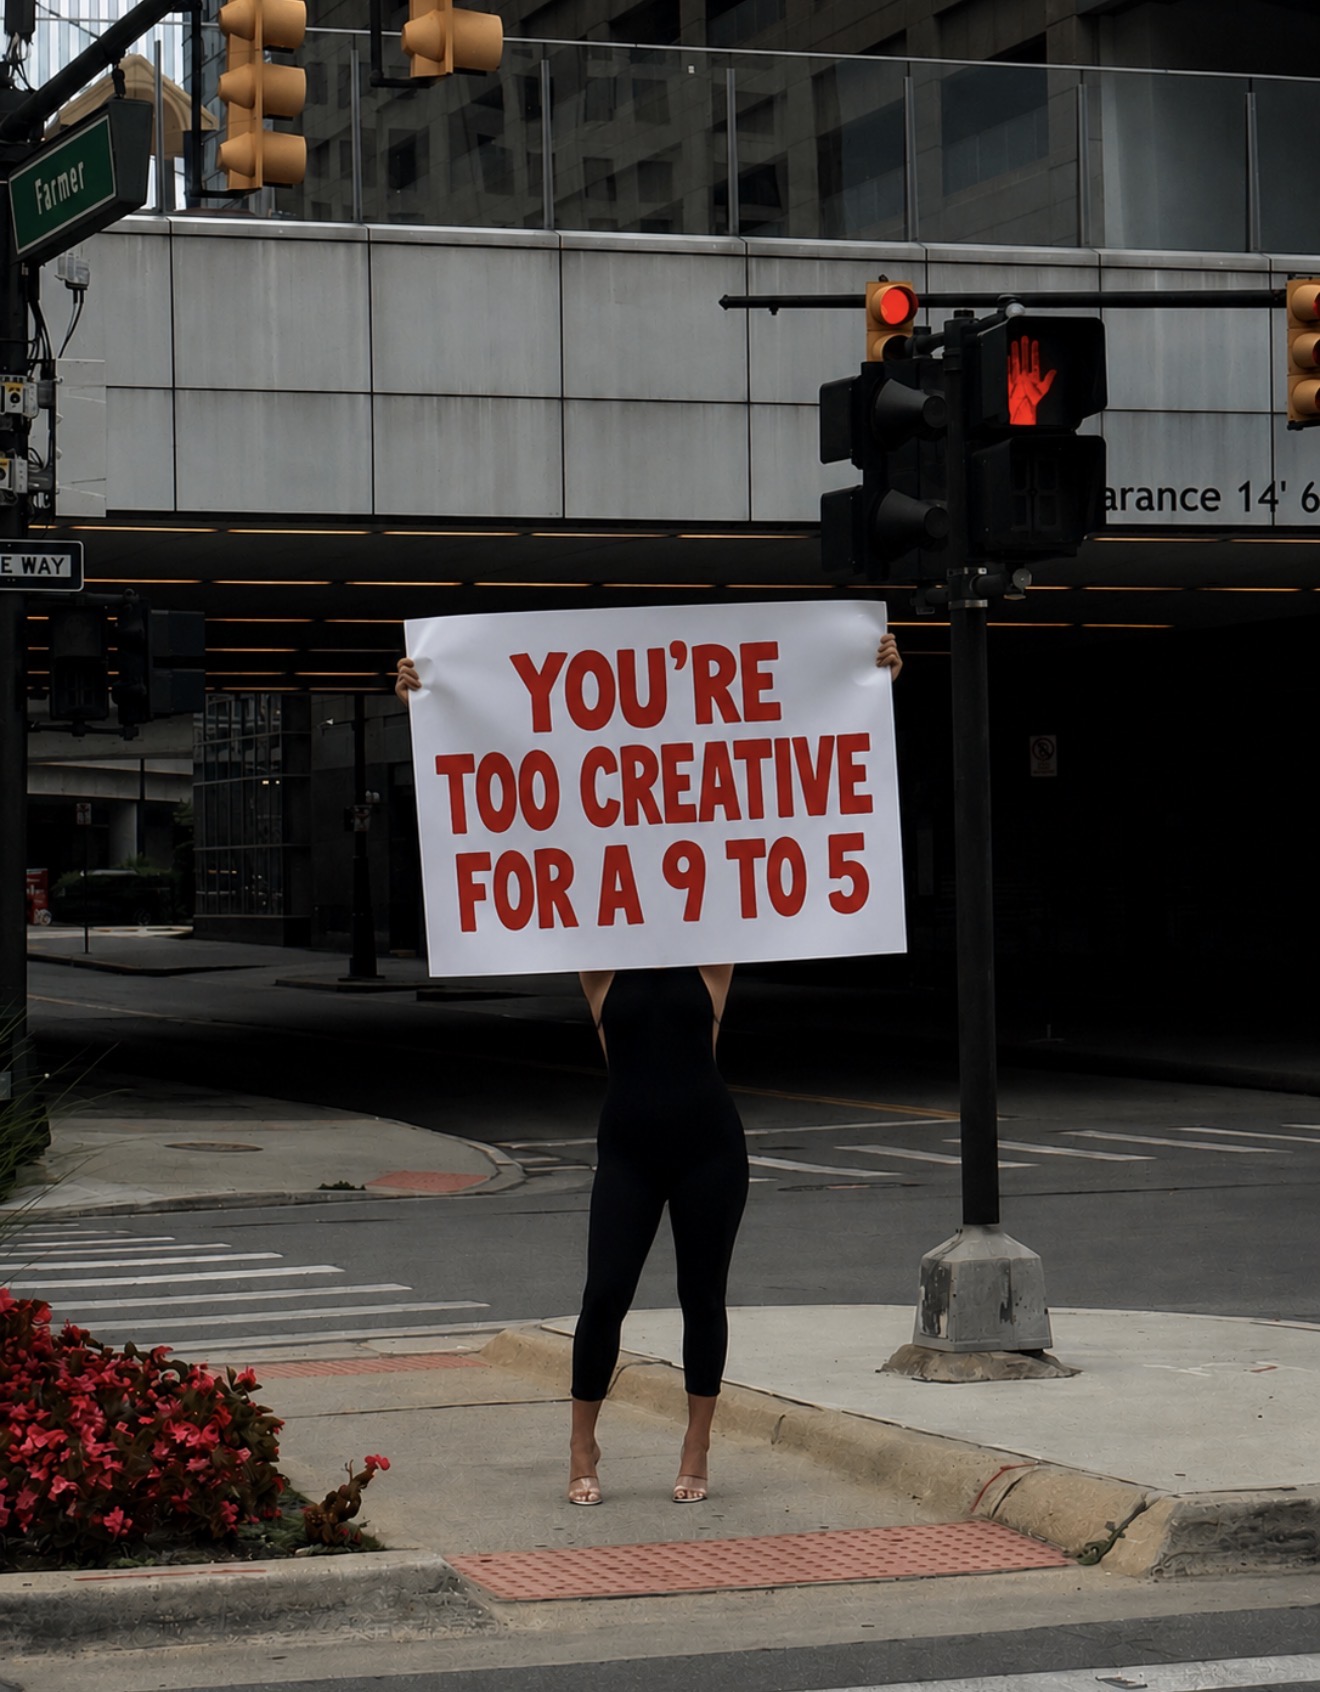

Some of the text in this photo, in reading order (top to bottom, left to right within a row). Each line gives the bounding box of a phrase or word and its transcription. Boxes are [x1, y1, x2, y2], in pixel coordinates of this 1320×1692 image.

[34, 160, 85, 216] Farmer
[1238, 480, 1287, 512] 14'
[21, 556, 65, 575] WAY
[511, 640, 782, 732] YOU'RE
[436, 733, 873, 834] TOO CREATIVE
[456, 832, 870, 932] FOR A 9 TO 5
